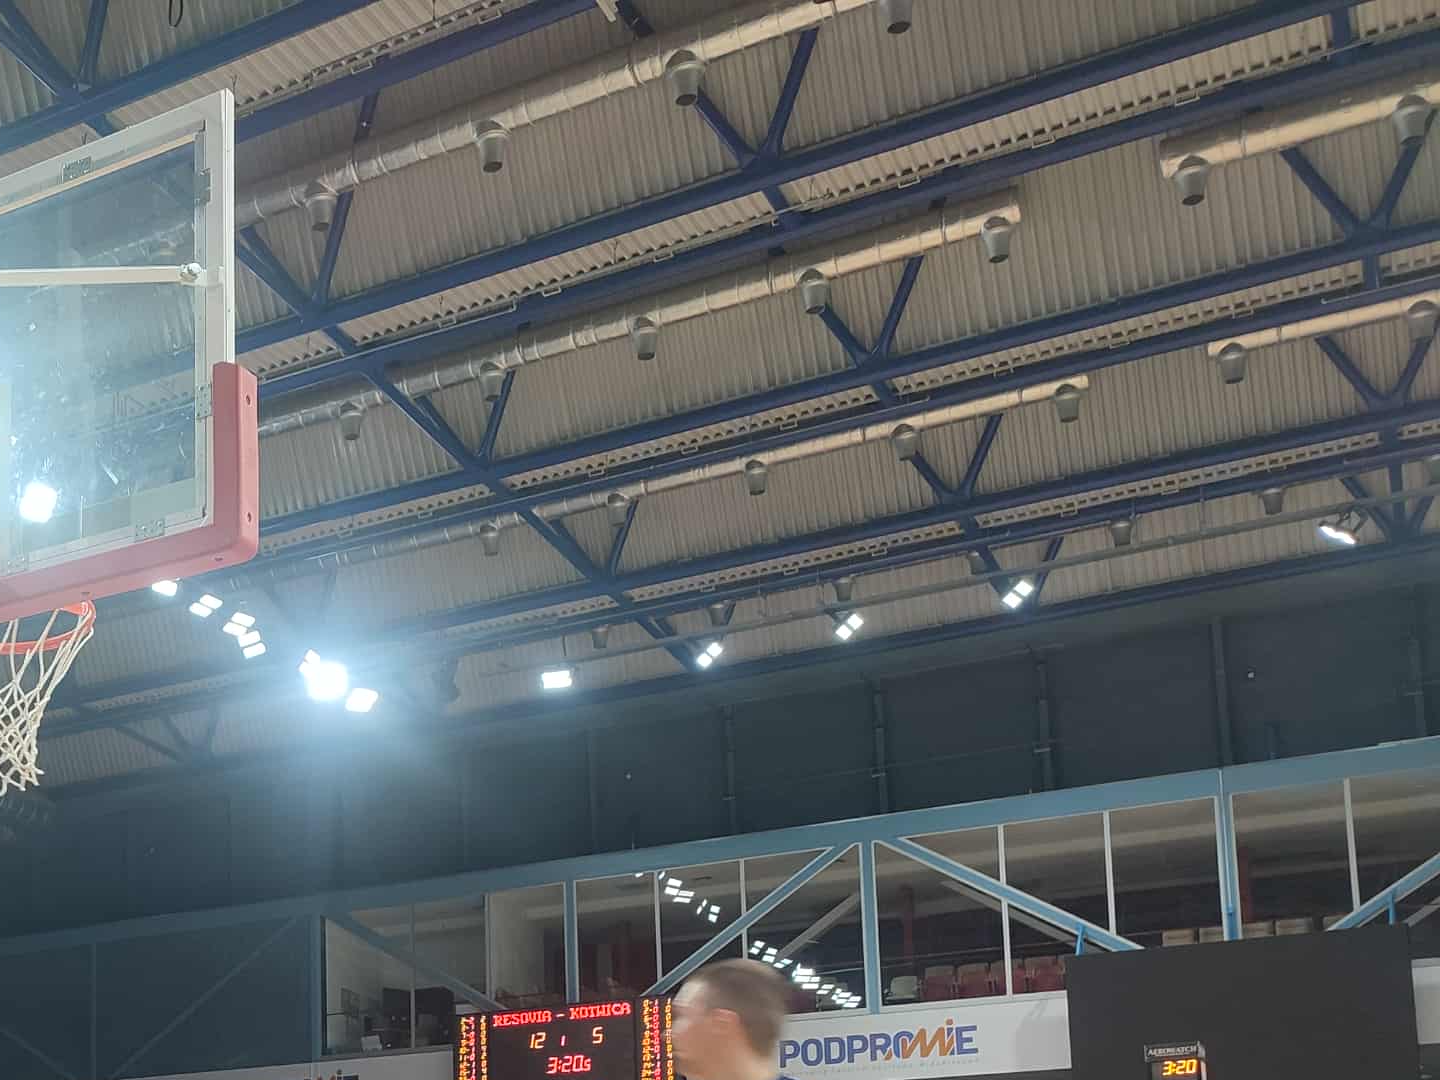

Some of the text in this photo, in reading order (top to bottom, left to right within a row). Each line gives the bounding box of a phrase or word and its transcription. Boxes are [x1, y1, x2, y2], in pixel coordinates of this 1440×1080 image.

[493, 1010, 553, 1027] RESOVIA
[569, 1002, 631, 1019] KOTWICA
[530, 1031, 547, 1050] 12
[592, 1026, 604, 1044] 5
[1162, 1059, 1198, 1076] 3:20
